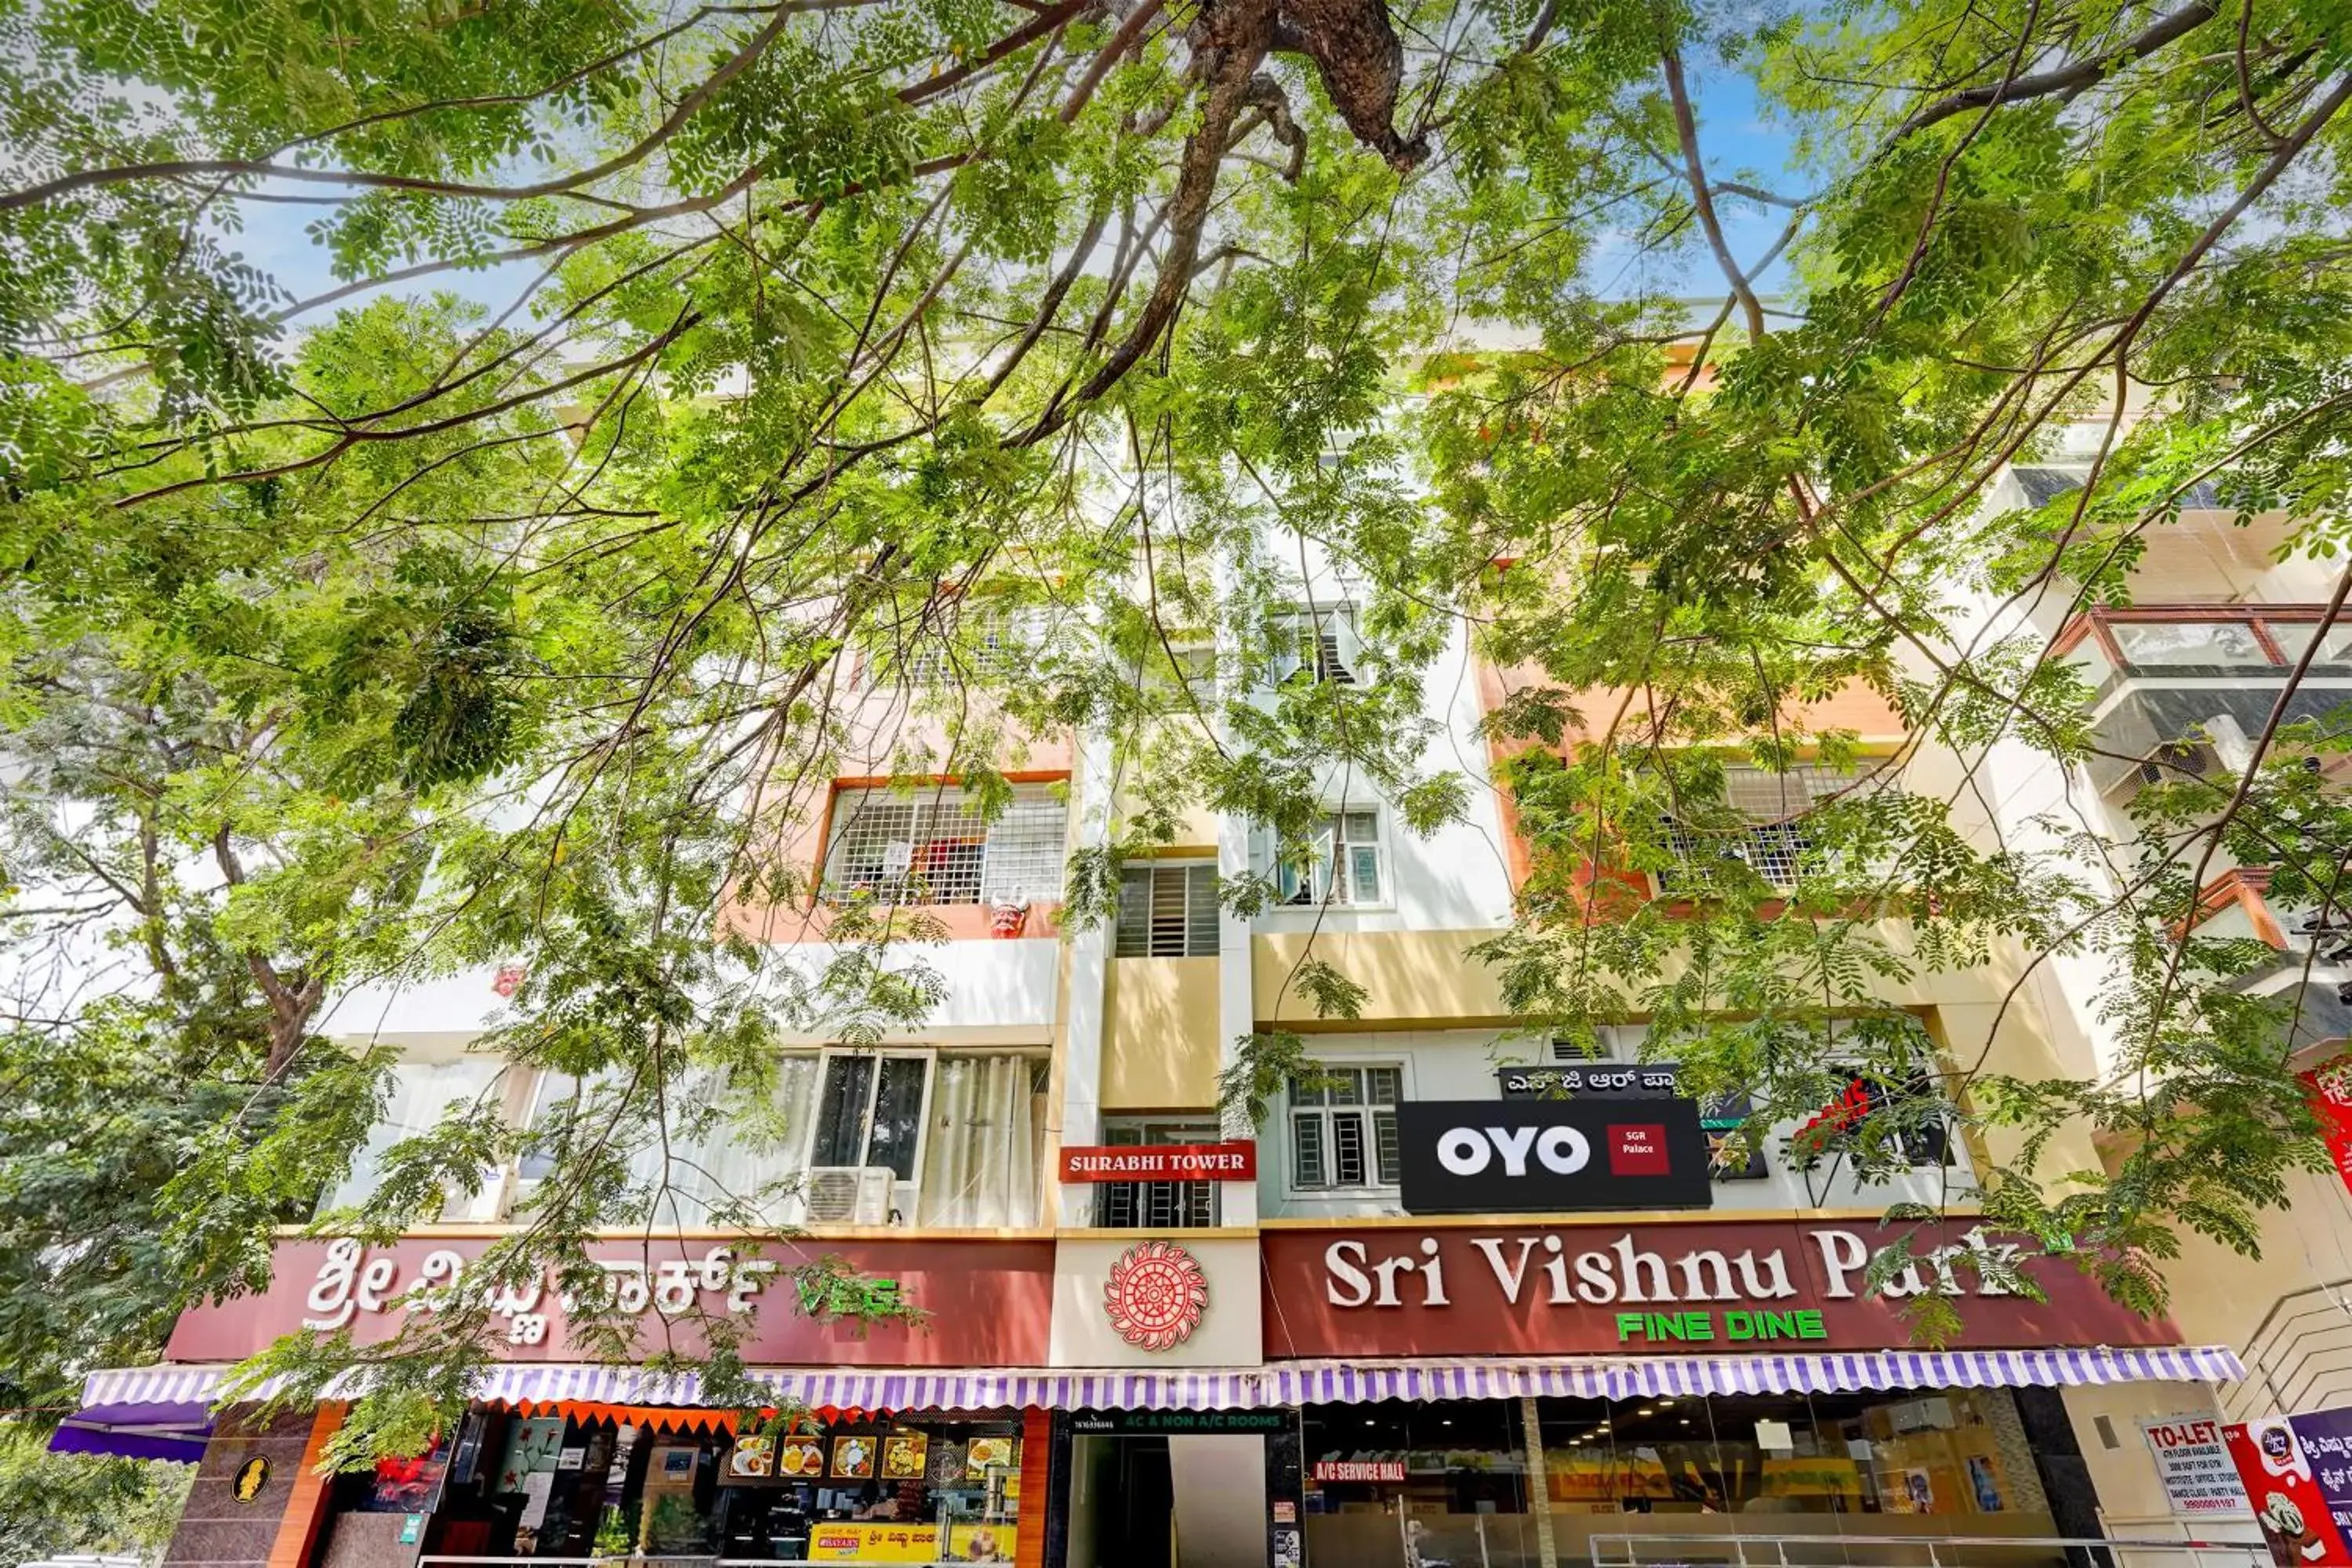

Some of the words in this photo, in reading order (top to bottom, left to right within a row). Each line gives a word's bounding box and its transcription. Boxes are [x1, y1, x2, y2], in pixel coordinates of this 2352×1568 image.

[1588, 1069, 1637, 1089] ಆರ್
[1625, 1131, 1646, 1141] SGR
[1436, 1125, 1592, 1177] OYO
[1622, 1143, 1653, 1154] Palace
[1069, 1155, 1165, 1172] SURABHI
[1169, 1153, 1245, 1171] TOWER
[1324, 1236, 1450, 1308] Sri
[1470, 1232, 1798, 1305] Vishnu
[1809, 1225, 2021, 1300] Park
[301, 1236, 394, 1331] ಶ್ರೀ
[1614, 1312, 1715, 1341] FINE
[1725, 1308, 1828, 1341] DINE
[1125, 1415, 1145, 1427] AC
[1163, 1415, 1195, 1427] NON
[1198, 1415, 1224, 1428] A/C
[1228, 1414, 1280, 1427] ROOMS
[2147, 1421, 2219, 1448] TO-LET
[1316, 1463, 1336, 1480] A/C
[1337, 1462, 1378, 1481] SERVICE
[1381, 1462, 1404, 1480] HALL
